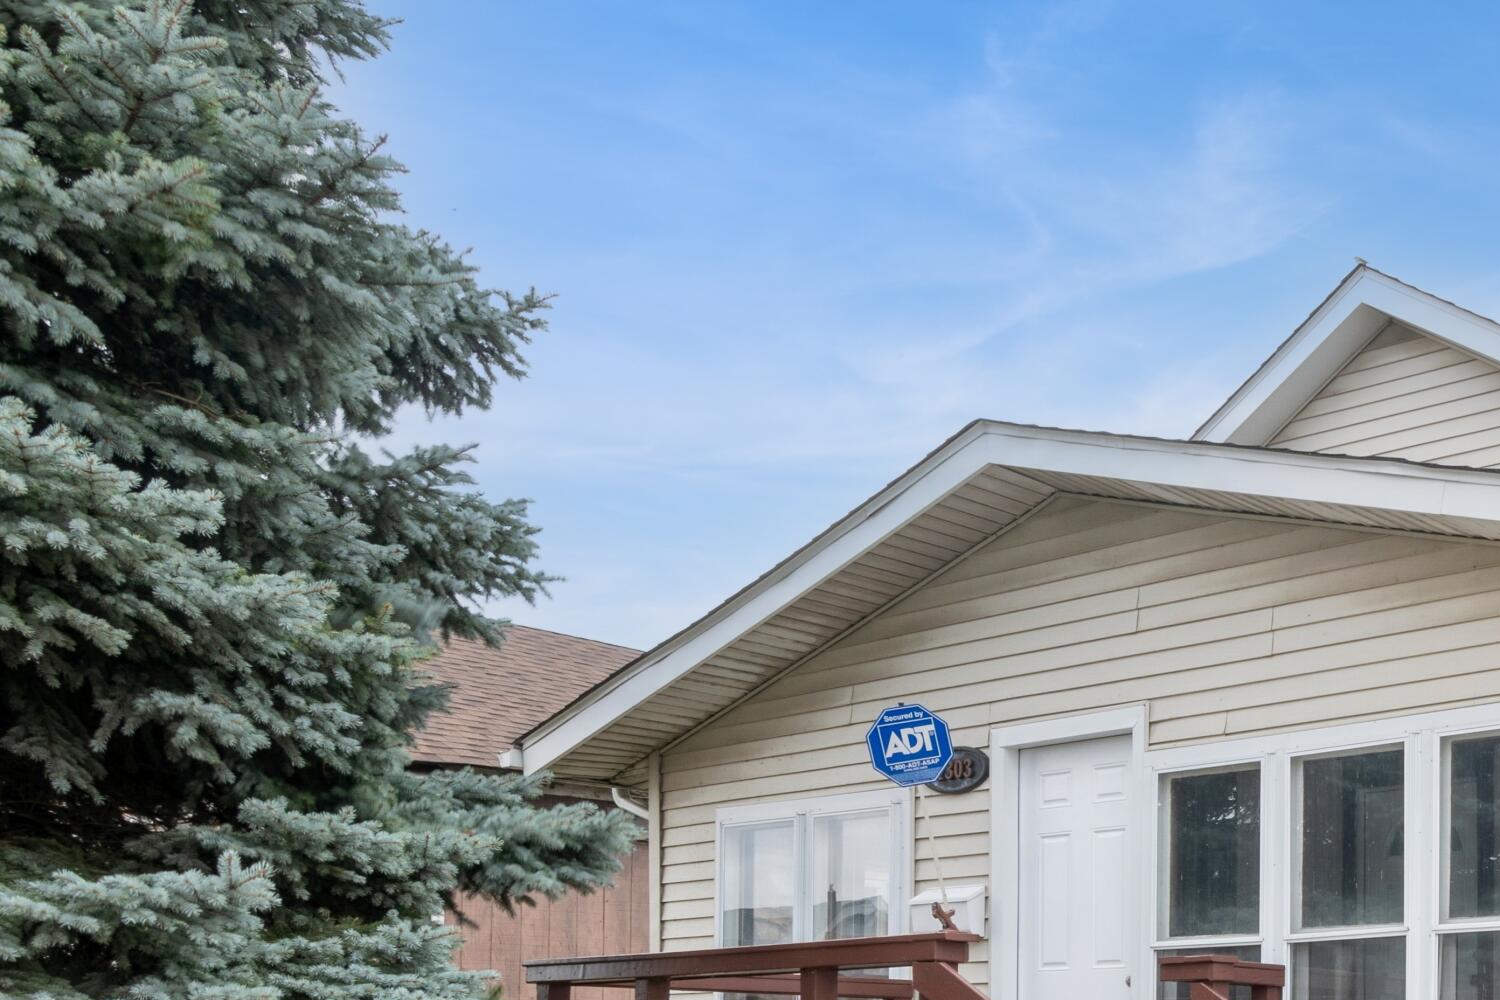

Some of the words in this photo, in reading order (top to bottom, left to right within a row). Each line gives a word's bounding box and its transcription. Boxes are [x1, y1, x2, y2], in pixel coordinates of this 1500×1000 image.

[884, 712, 913, 722] Secured
[914, 711, 923, 719] by
[886, 725, 934, 758] ADT
[939, 759, 972, 780] 303
